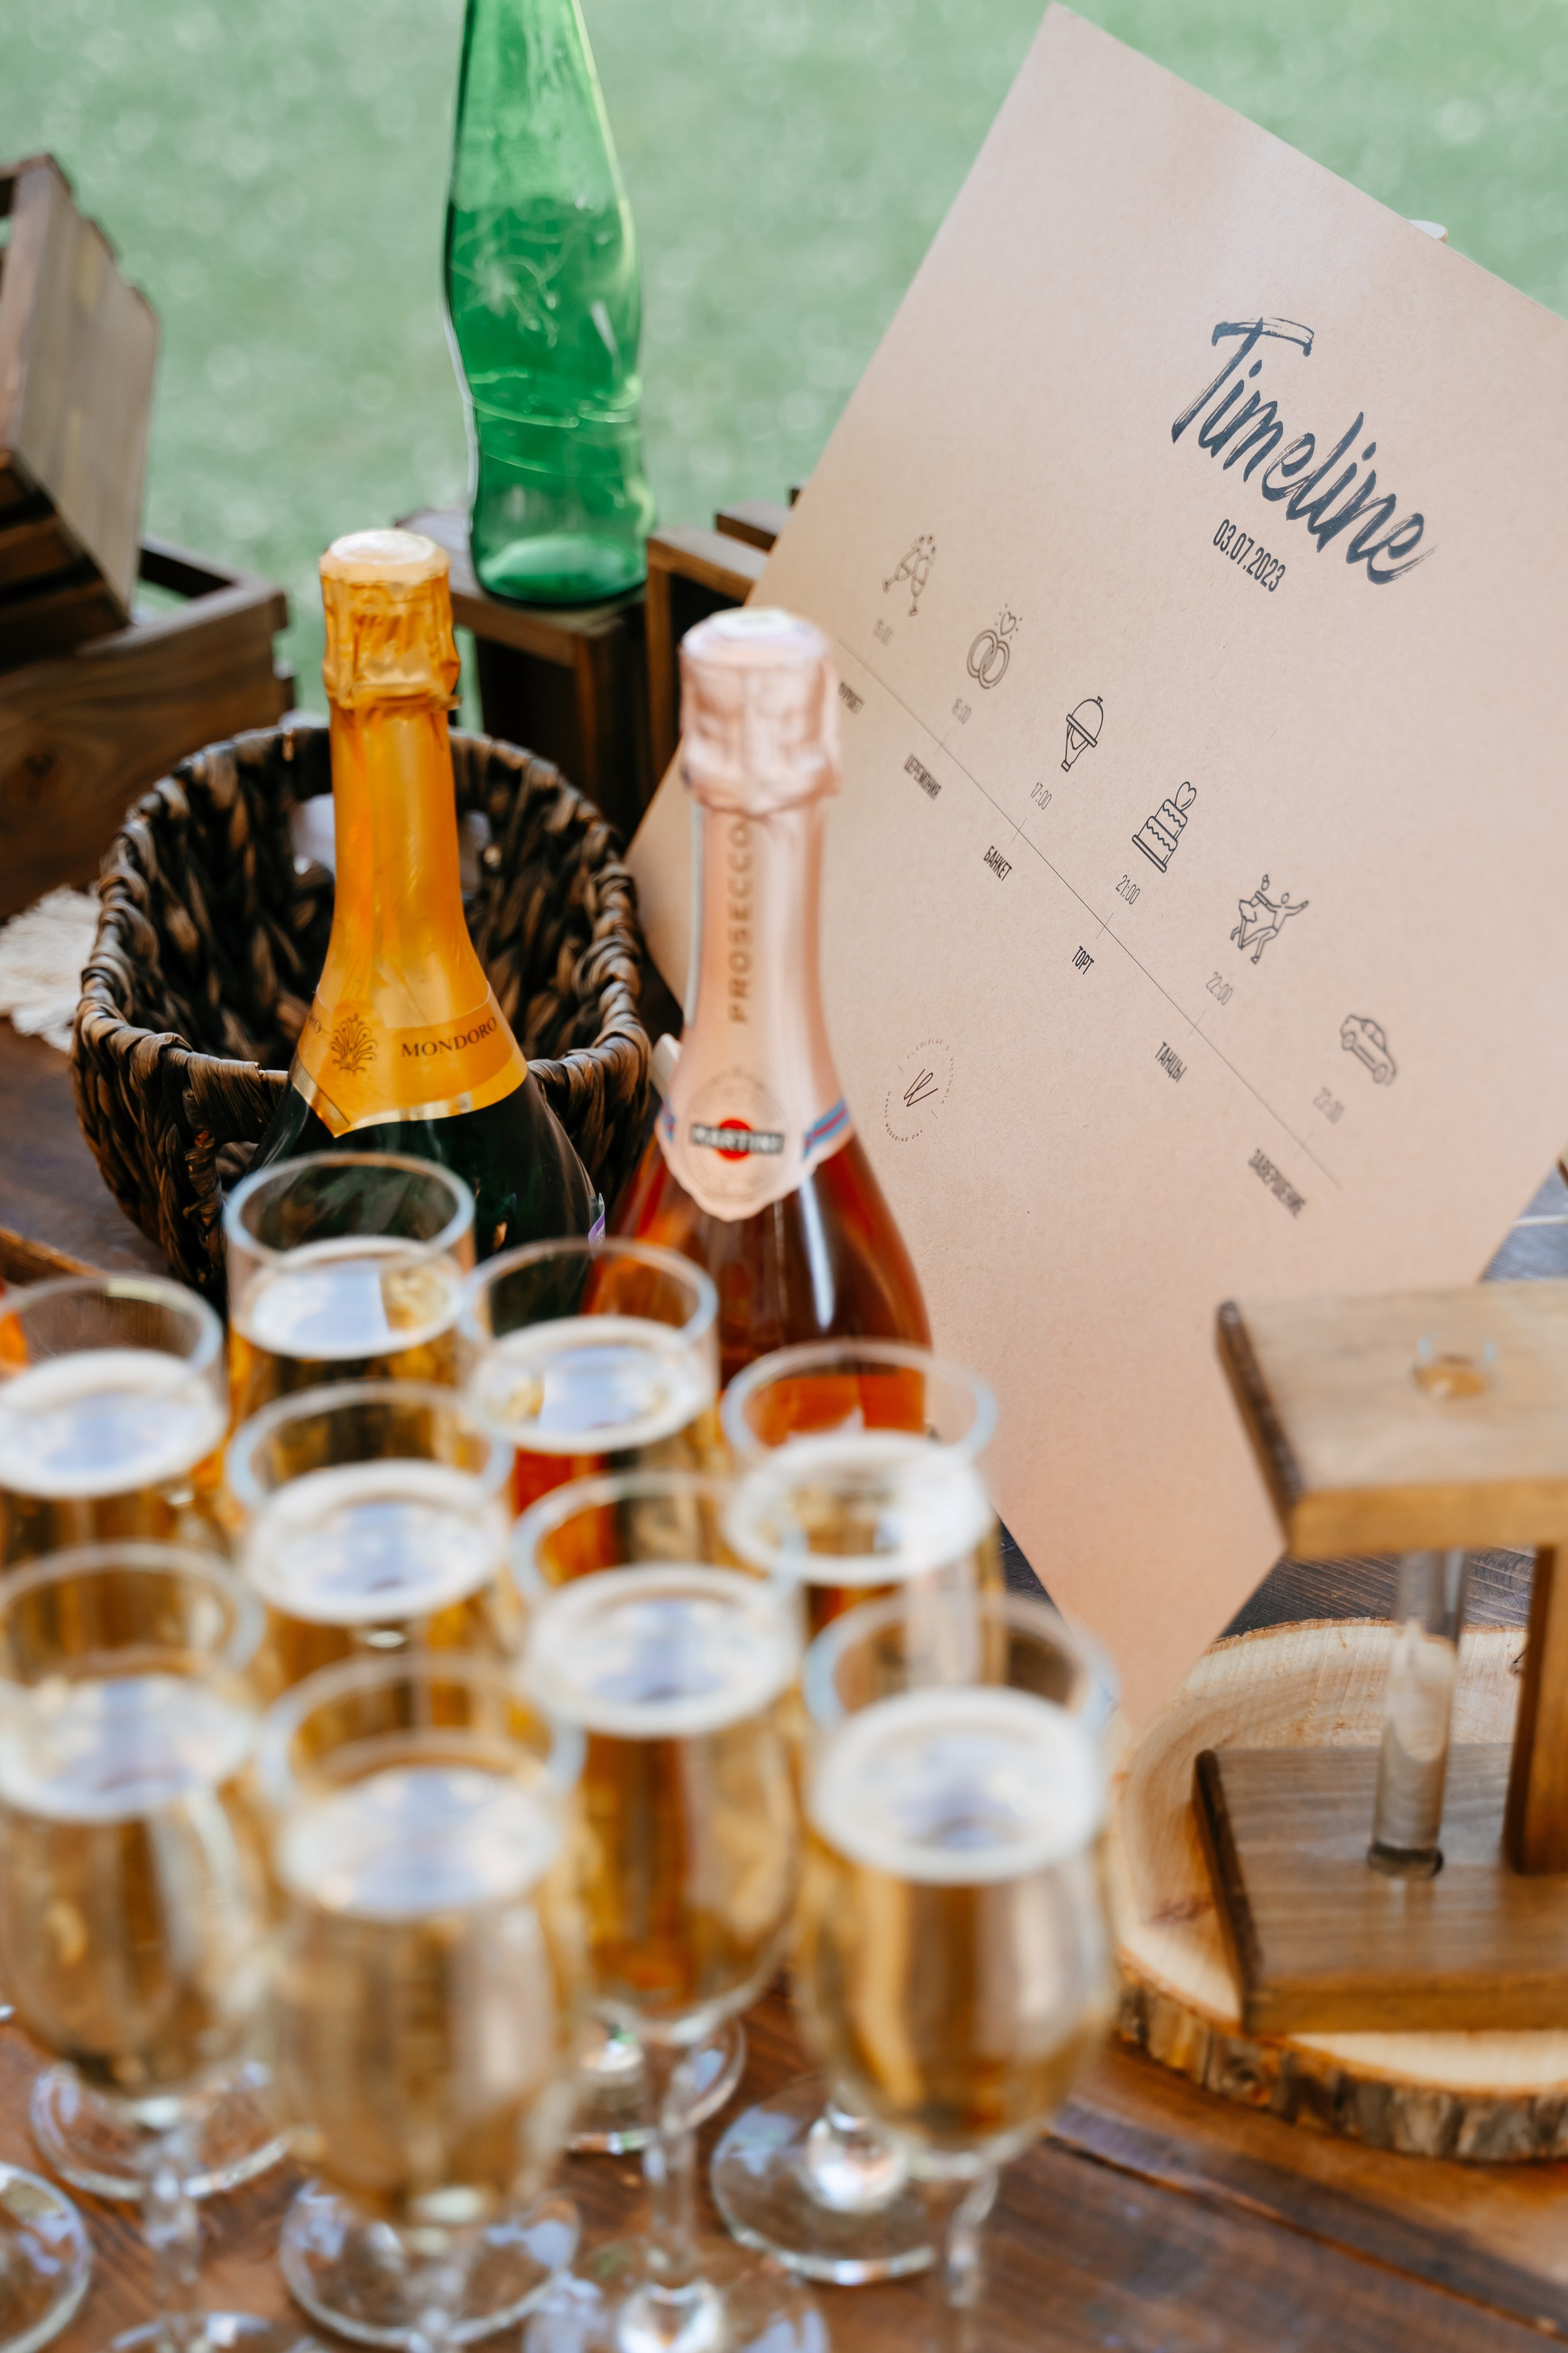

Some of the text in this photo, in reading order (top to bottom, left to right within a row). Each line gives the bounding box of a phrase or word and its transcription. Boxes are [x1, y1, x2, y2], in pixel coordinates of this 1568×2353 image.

[1171, 317, 1438, 584] Timeline
[1213, 519, 1286, 592] 03.07.2023
[1030, 782, 1052, 810] 17:00
[983, 845, 1012, 882] БАНКЕТ
[1115, 874, 1140, 905] 21:00
[728, 821, 752, 1023] PROSECCO
[1072, 945, 1095, 975] ТОРТ
[1205, 971, 1234, 1005] 22:00
[401, 1016, 497, 1059] MONDORO
[1155, 1041, 1187, 1083] ТАНЦЫ
[911, 1129, 922, 1140] DAY
